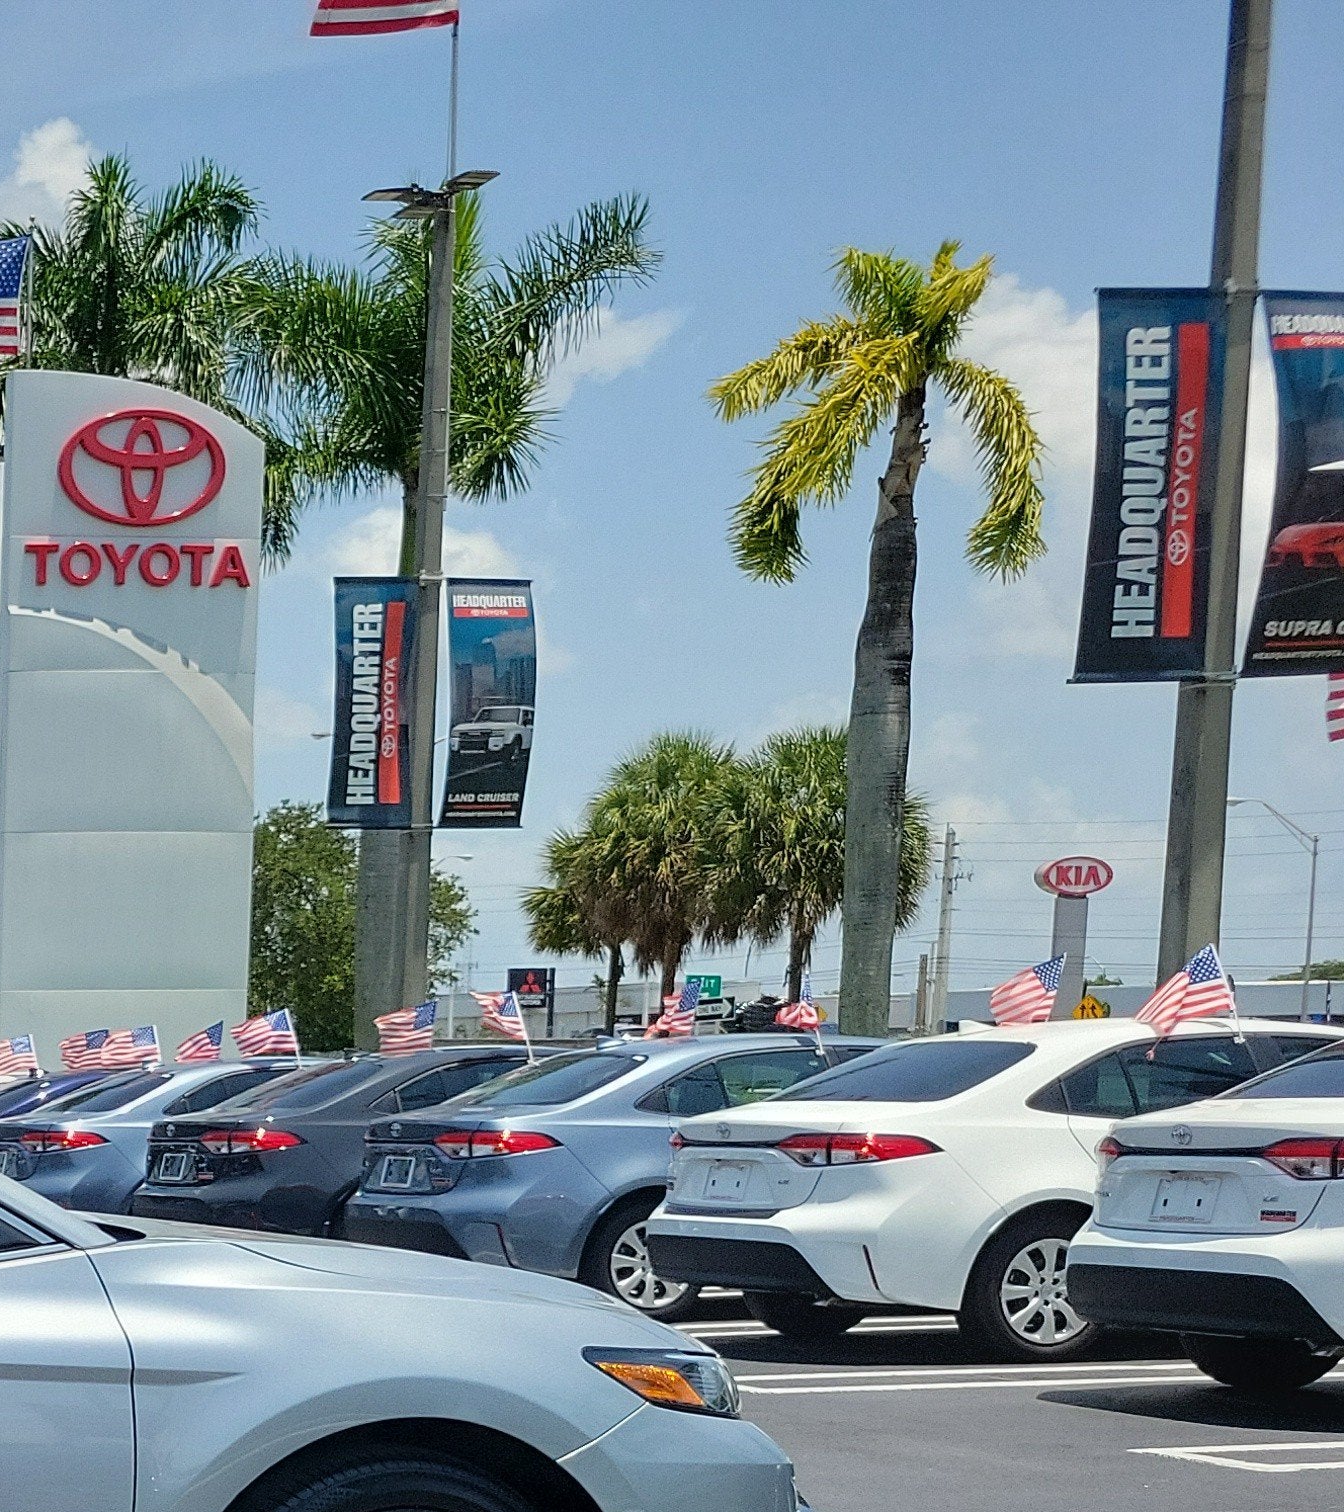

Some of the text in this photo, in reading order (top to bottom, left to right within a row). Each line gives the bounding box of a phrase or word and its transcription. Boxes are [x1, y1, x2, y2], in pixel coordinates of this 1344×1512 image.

[1111, 325, 1172, 638] HEADQUARTER
[1171, 409, 1197, 526] TOYOTA
[24, 541, 250, 588] TOYOTA
[453, 595, 527, 608] HEADQUARTER
[1263, 620, 1333, 637] SUPRA
[346, 602, 383, 805] HEADQUARTER
[381, 657, 397, 732] TOYOTA
[448, 792, 520, 802] LAND CRUISER
[1056, 866, 1102, 886] KIA
